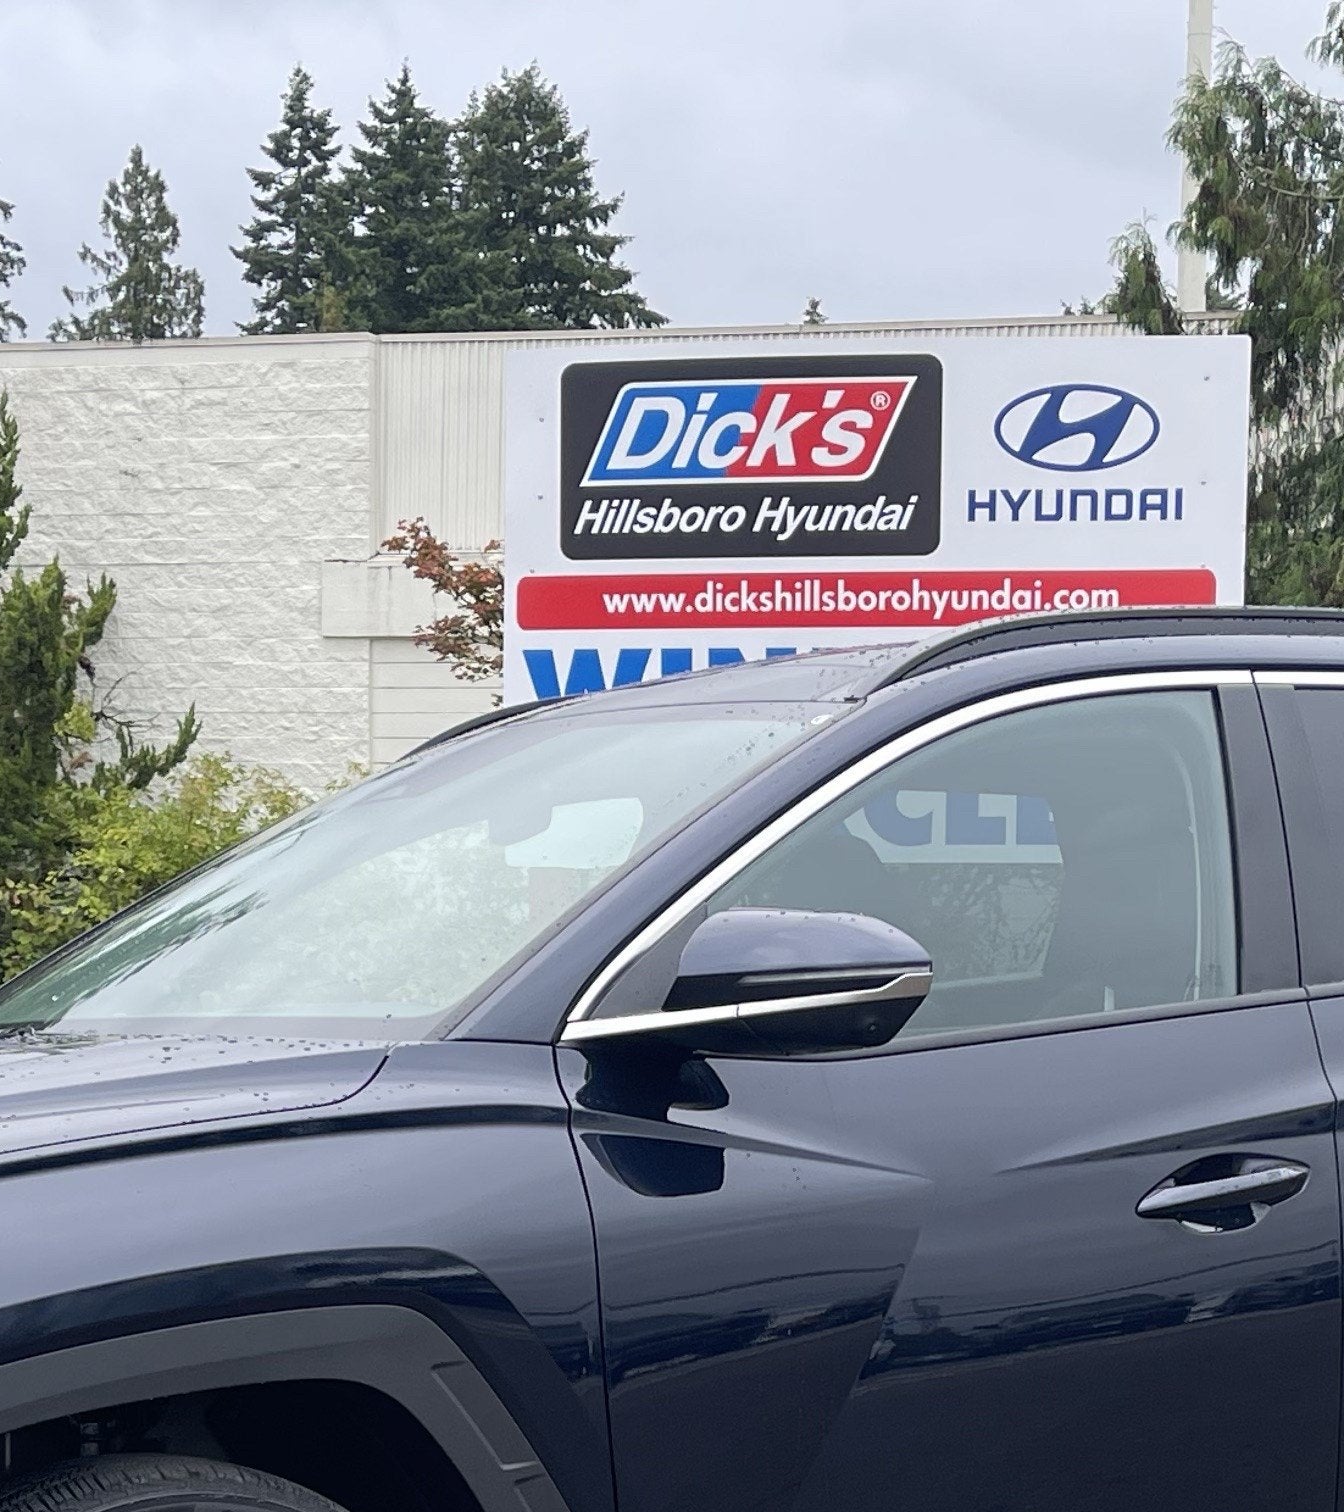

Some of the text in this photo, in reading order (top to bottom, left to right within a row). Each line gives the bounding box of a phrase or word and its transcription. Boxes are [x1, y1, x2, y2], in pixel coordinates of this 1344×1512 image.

[606, 389, 874, 470] Dick's
[573, 495, 919, 541] Hillsboro Hyundai
[967, 487, 1184, 523] HYUNDAI
[603, 578, 1121, 619] www.dickshillsborohyundai.com
